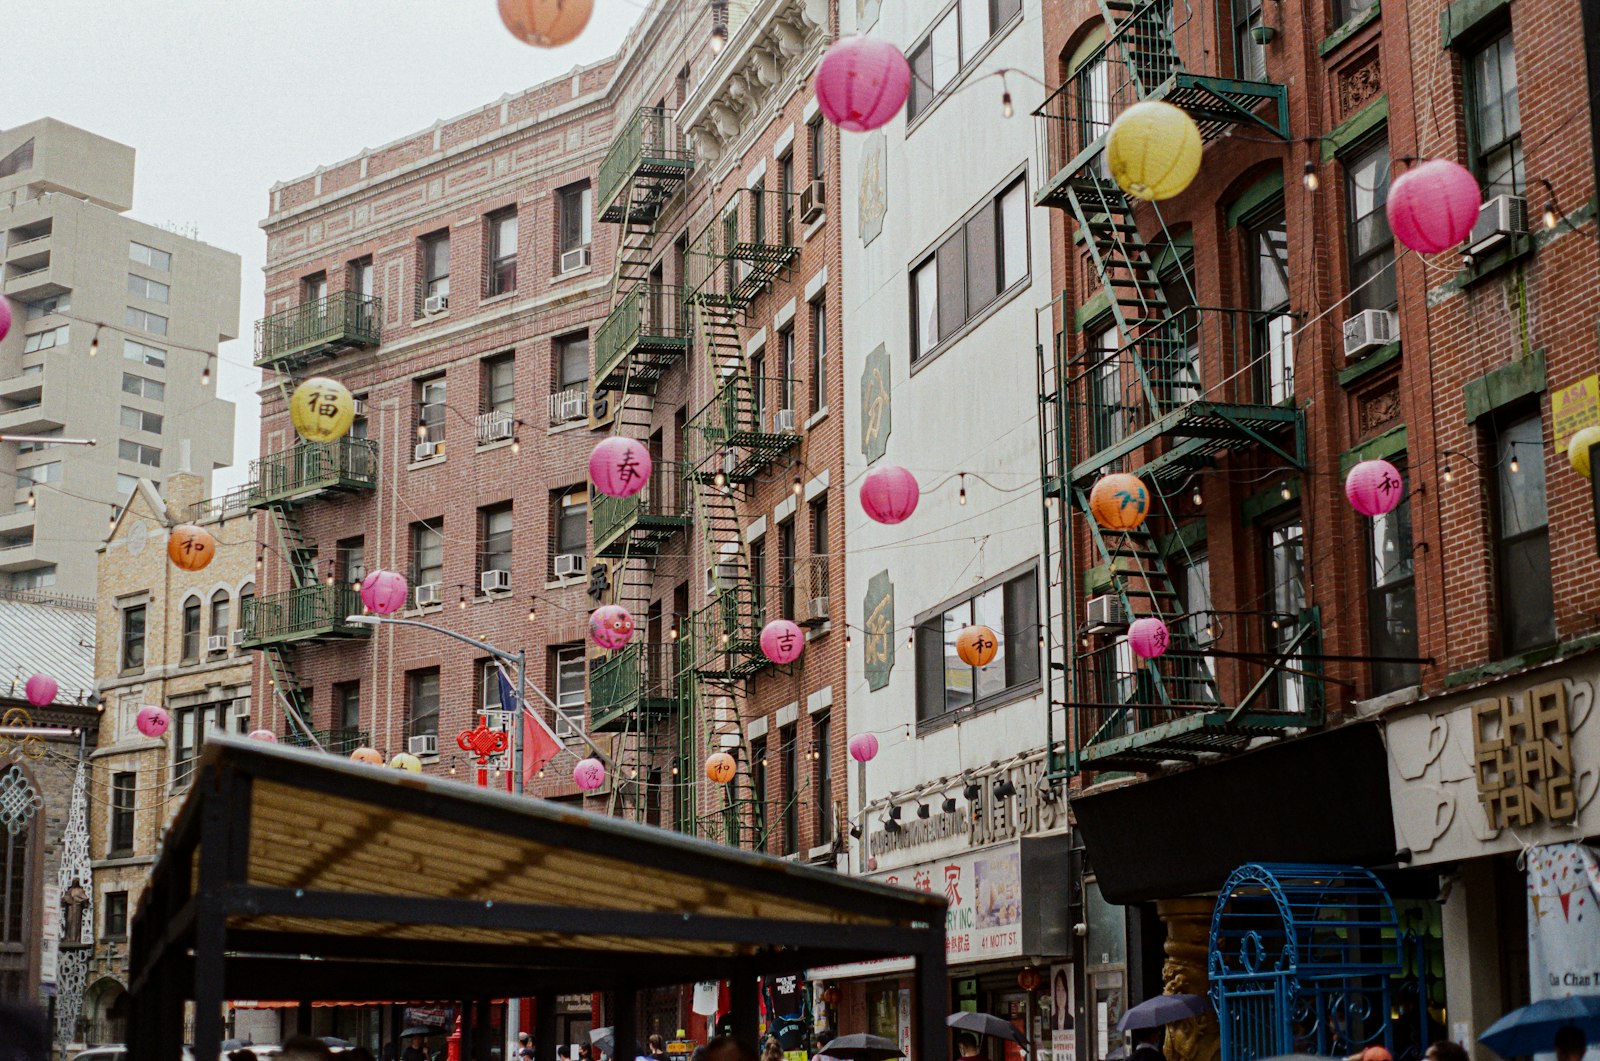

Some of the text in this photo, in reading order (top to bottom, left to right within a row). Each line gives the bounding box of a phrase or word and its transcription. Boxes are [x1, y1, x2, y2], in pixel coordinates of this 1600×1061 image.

[309, 385, 338, 418] 福
[617, 448, 640, 484] 春
[1377, 472, 1399, 496] 和
[180, 534, 204, 555] 和
[777, 629, 797, 651] 吉
[972, 634, 993, 653] 和
[147, 713, 164, 726] 和
[1472, 682, 1567, 752] CHA
[714, 760, 730, 773] 和
[1475, 734, 1571, 792] CHAN
[1478, 775, 1576, 830] TANG
[959, 907, 975, 929] INC.
[981, 931, 1018, 949] 41 MOTT ST.
[1563, 972, 1590, 986] Chan
